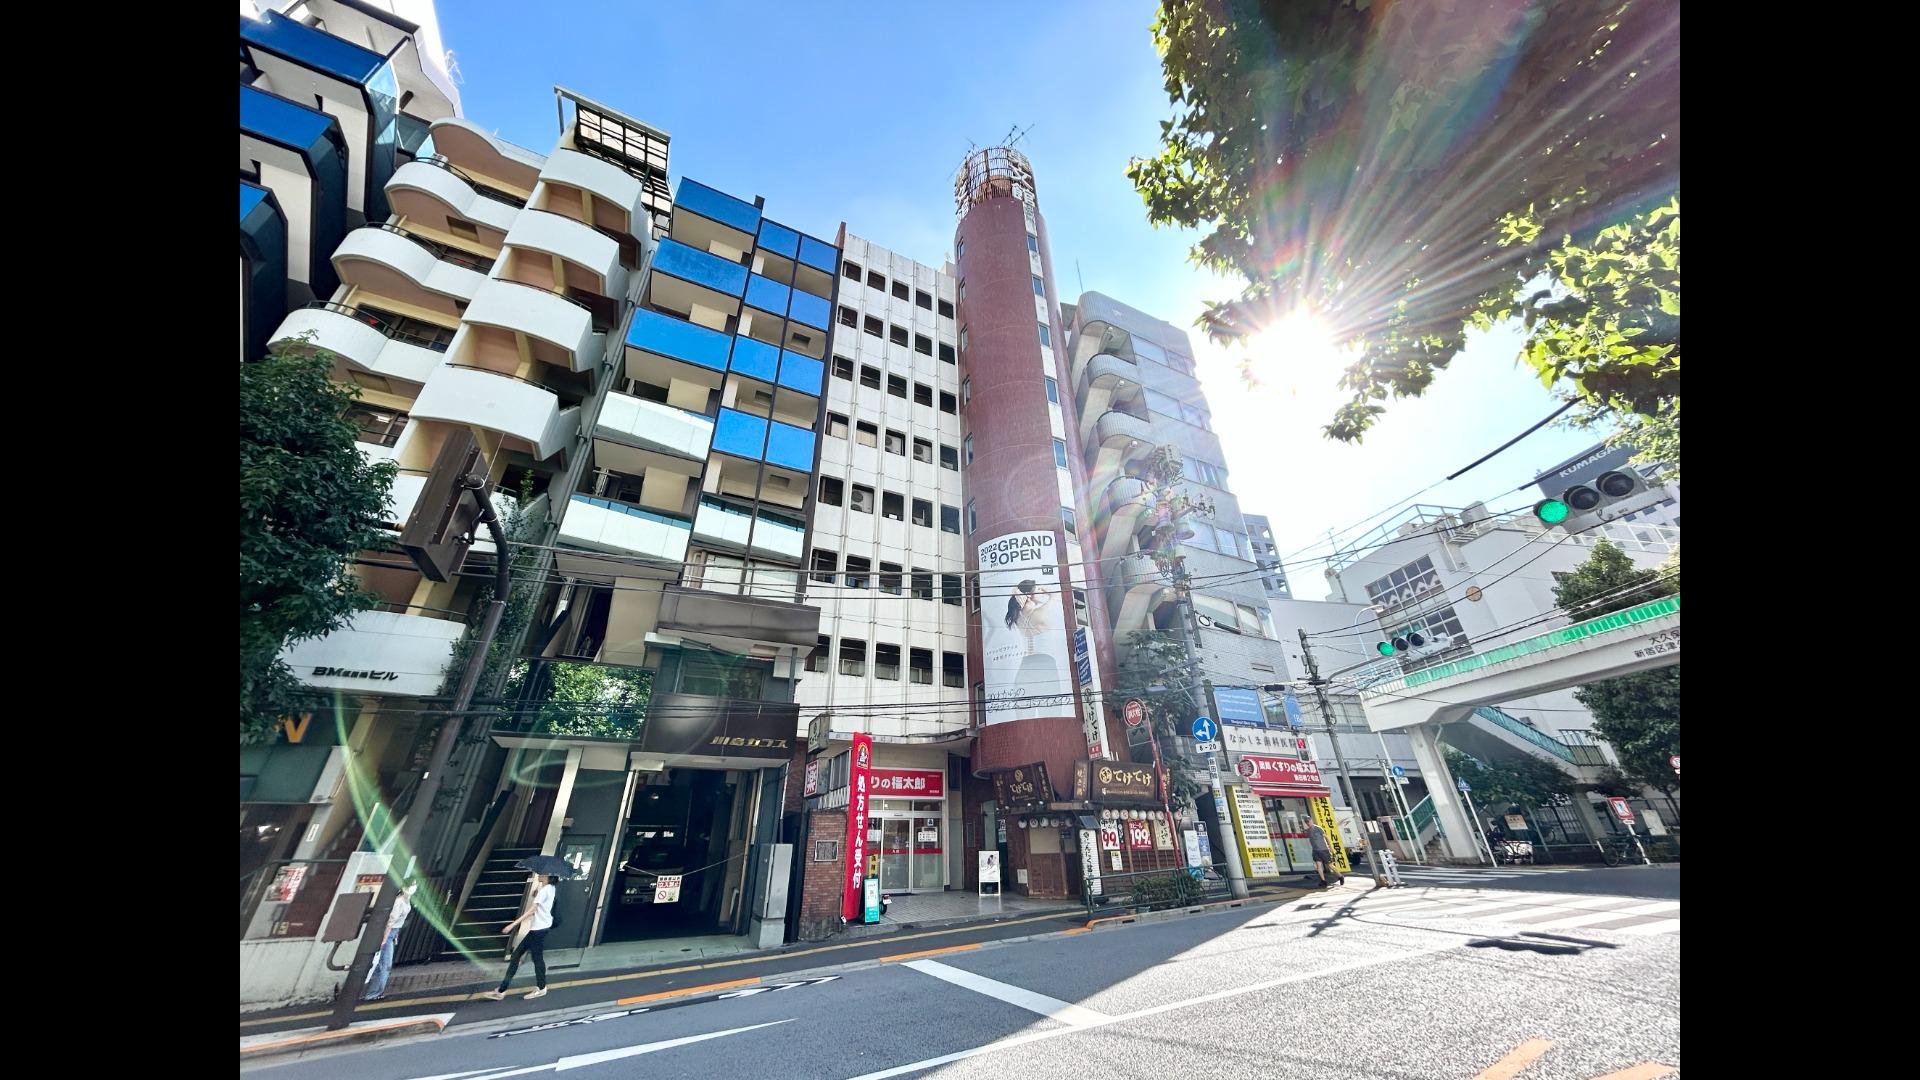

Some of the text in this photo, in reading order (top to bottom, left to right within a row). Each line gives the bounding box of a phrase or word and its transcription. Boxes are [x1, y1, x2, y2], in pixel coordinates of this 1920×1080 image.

[980, 543, 998, 557] 2022
[998, 535, 1053, 552] GRAND
[990, 552, 997, 563] 9
[998, 548, 1042, 565] OPEN
[1113, 769, 1152, 786] てけてけ
[853, 773, 866, 889] 処方せん受付
